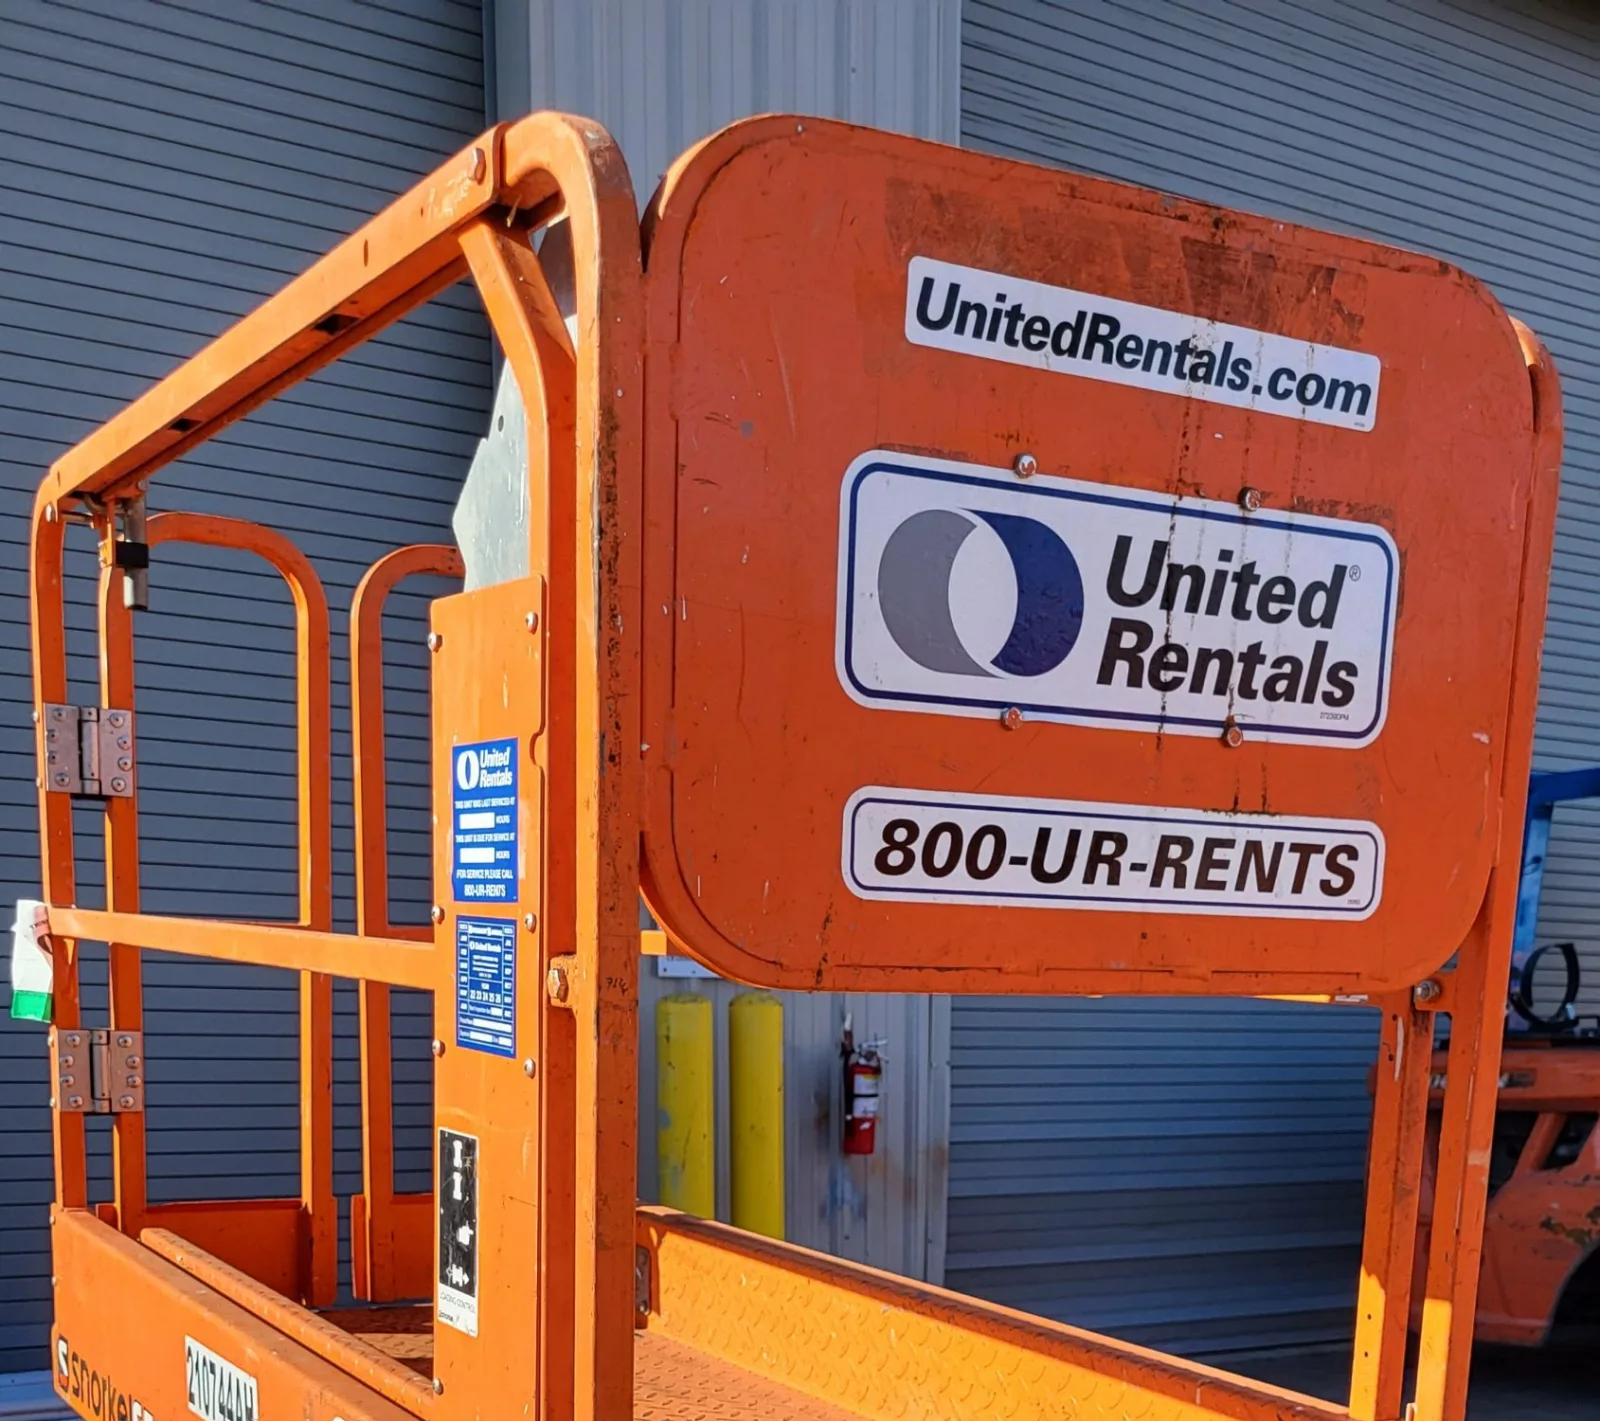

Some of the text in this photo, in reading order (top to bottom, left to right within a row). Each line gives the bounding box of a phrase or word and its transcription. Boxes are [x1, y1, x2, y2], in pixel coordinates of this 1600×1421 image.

[915, 275, 1372, 416] UnitedRentals.com
[1105, 534, 1348, 630] United
[1097, 618, 1359, 708] Rentals
[480, 747, 511, 769] United
[480, 767, 513, 789] Rentals
[873, 817, 1360, 898] 800-UR-RENTS
